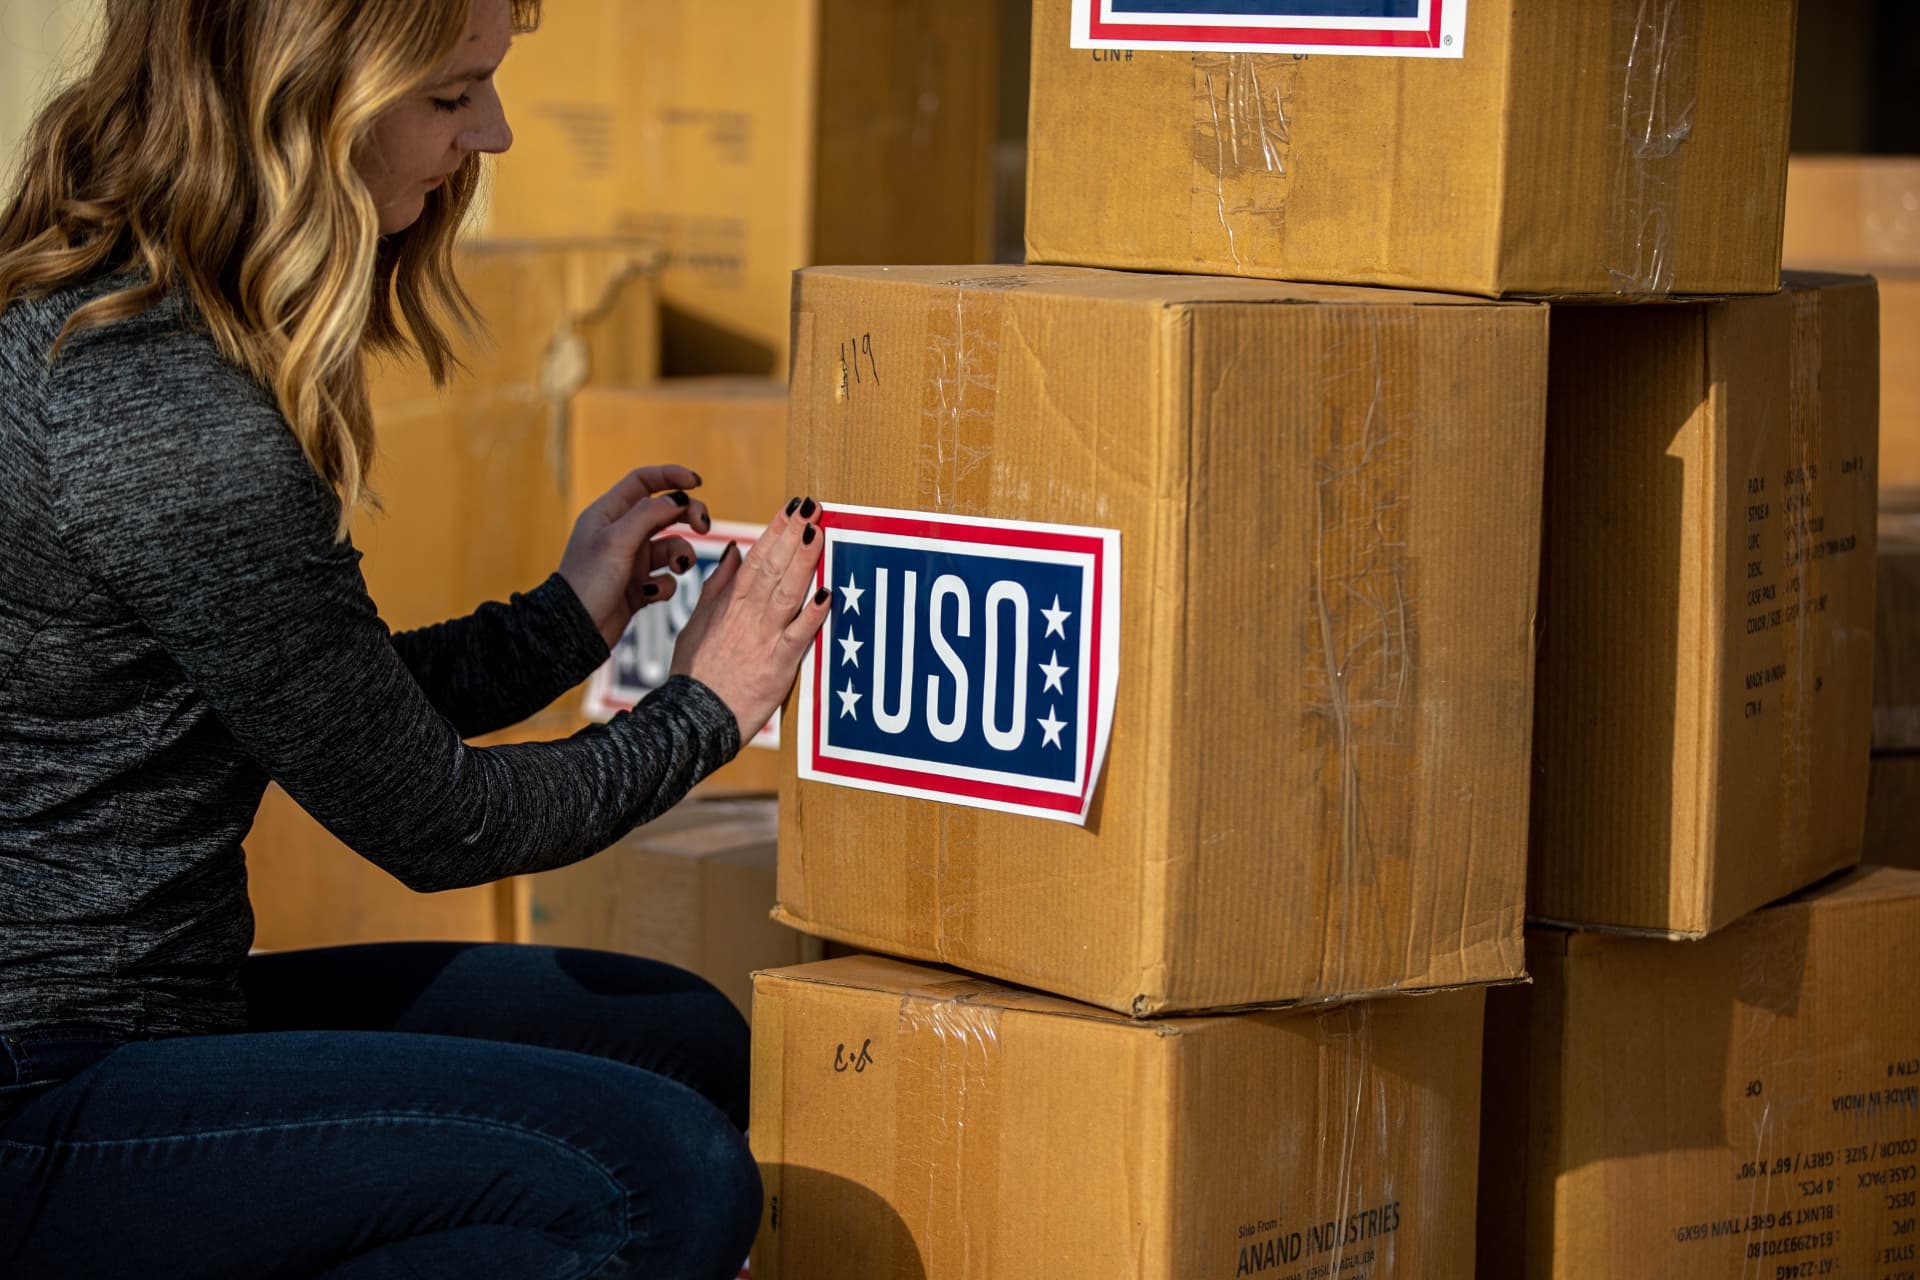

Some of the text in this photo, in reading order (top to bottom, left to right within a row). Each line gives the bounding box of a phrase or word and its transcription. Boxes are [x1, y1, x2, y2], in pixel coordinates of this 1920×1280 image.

[871, 567, 1030, 752] USO
[1897, 1058, 1919, 1076] CTN
[1745, 1079, 1762, 1097] OF
[1832, 1086, 1919, 1112] MADE IN INDIA
[1845, 1145, 1868, 1164] SIZE
[1880, 1137, 1918, 1158] COLOR
[1760, 1160, 1768, 1175] X
[1803, 1151, 1834, 1169] GREY
[1857, 1170, 1886, 1189] PACK
[1885, 1164, 1916, 1182] CASE
[1826, 1178, 1834, 1194] 4
[1743, 1213, 1776, 1232] GREY
[1778, 1211, 1793, 1227] SP
[1796, 1204, 1834, 1225] BLNKT
[1237, 1221, 1256, 1239] Ship
[1710, 1218, 1740, 1237] TWN
[1893, 1218, 1915, 1237] UPC
[1236, 1201, 1401, 1279] ANAND INDUSTRIES
[1882, 1243, 1915, 1265] STYLE
